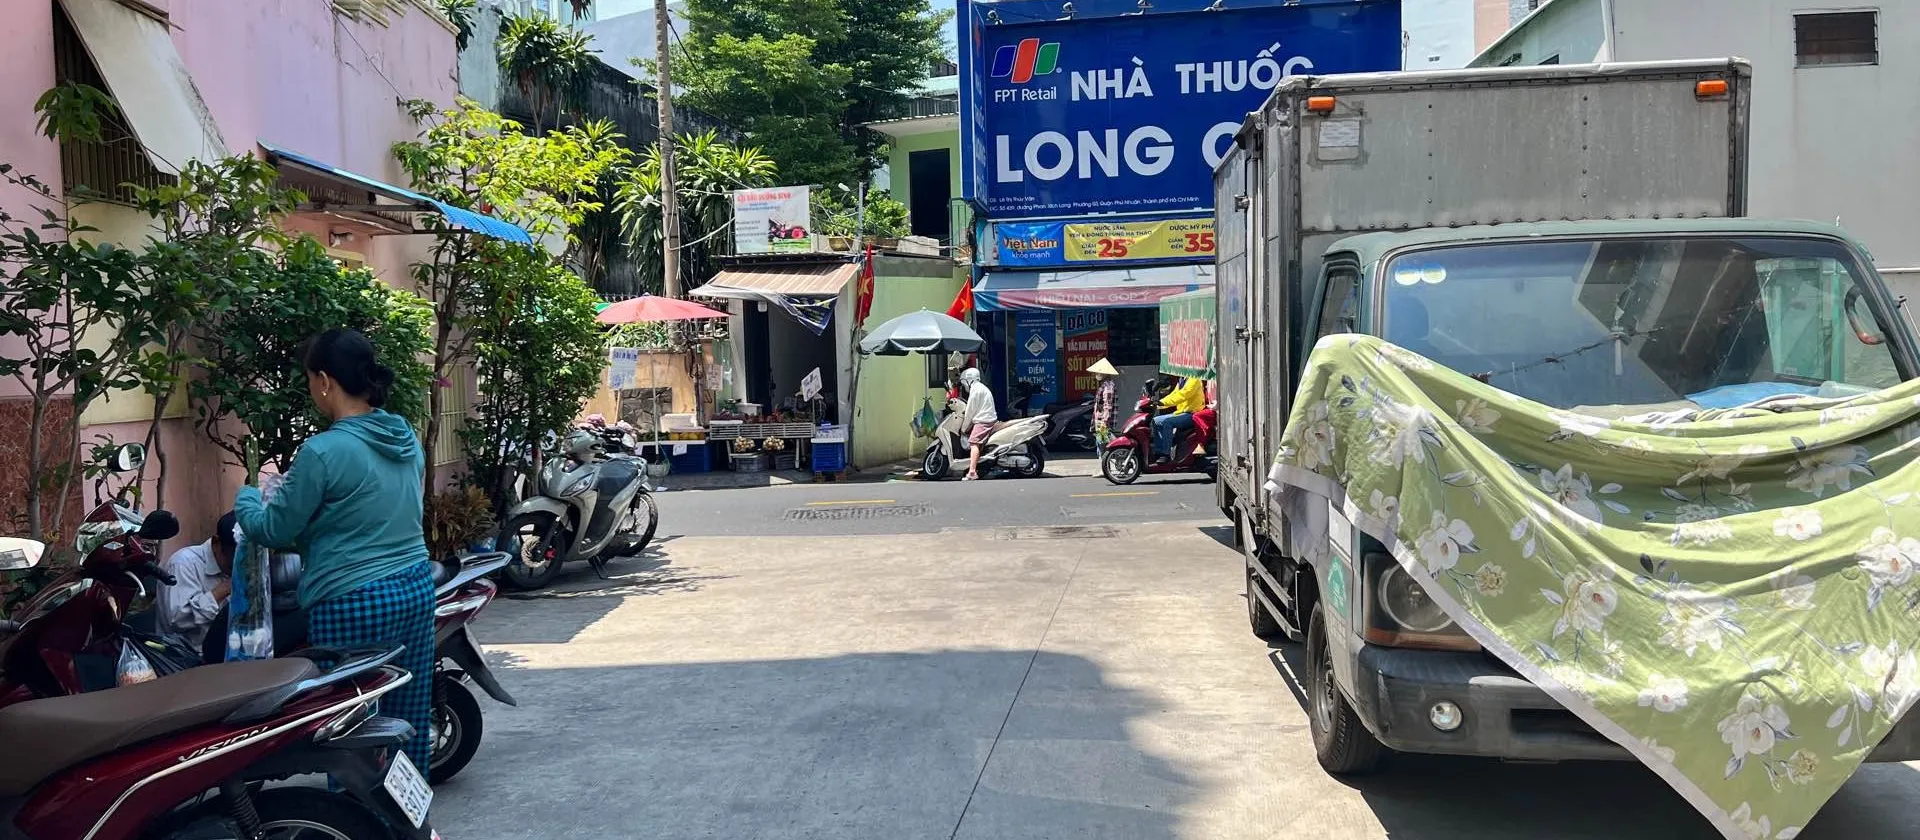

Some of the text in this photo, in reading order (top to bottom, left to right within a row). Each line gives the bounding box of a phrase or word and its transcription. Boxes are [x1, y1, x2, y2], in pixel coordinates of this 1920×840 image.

[1070, 42, 1314, 101] NHÀ THUỐC
[995, 86, 1057, 103] FPT Retail
[996, 125, 1175, 183] LONG
[1029, 236, 1058, 249] Nam
